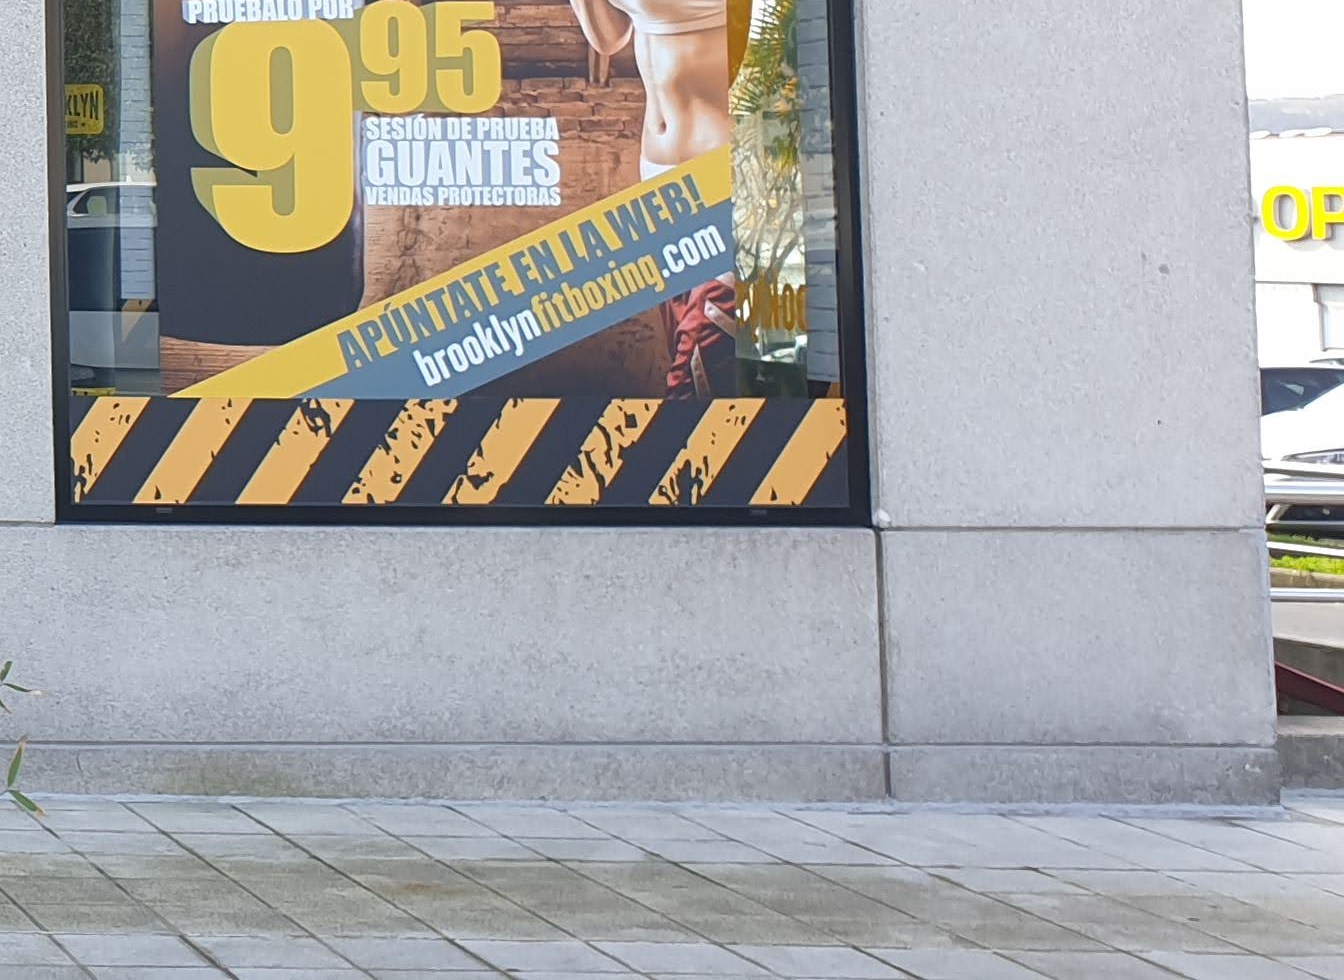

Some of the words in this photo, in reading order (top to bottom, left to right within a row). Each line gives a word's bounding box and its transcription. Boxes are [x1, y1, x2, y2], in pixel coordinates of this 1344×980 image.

[190, 18, 355, 254] 9
[365, 113, 443, 141] SESIÓN
[446, 117, 473, 141] DE
[476, 117, 561, 141] PRUEBA
[365, 140, 562, 187] GUANTES
[364, 186, 434, 206] VENDAS
[437, 186, 562, 207] PROTECTORAS
[336, 262, 514, 372] APÚNTATE
[507, 239, 558, 291] EN
[555, 222, 606, 272] LA
[605, 173, 706, 252] WEB!
[412, 223, 726, 388] brooklynfitboxing.com
